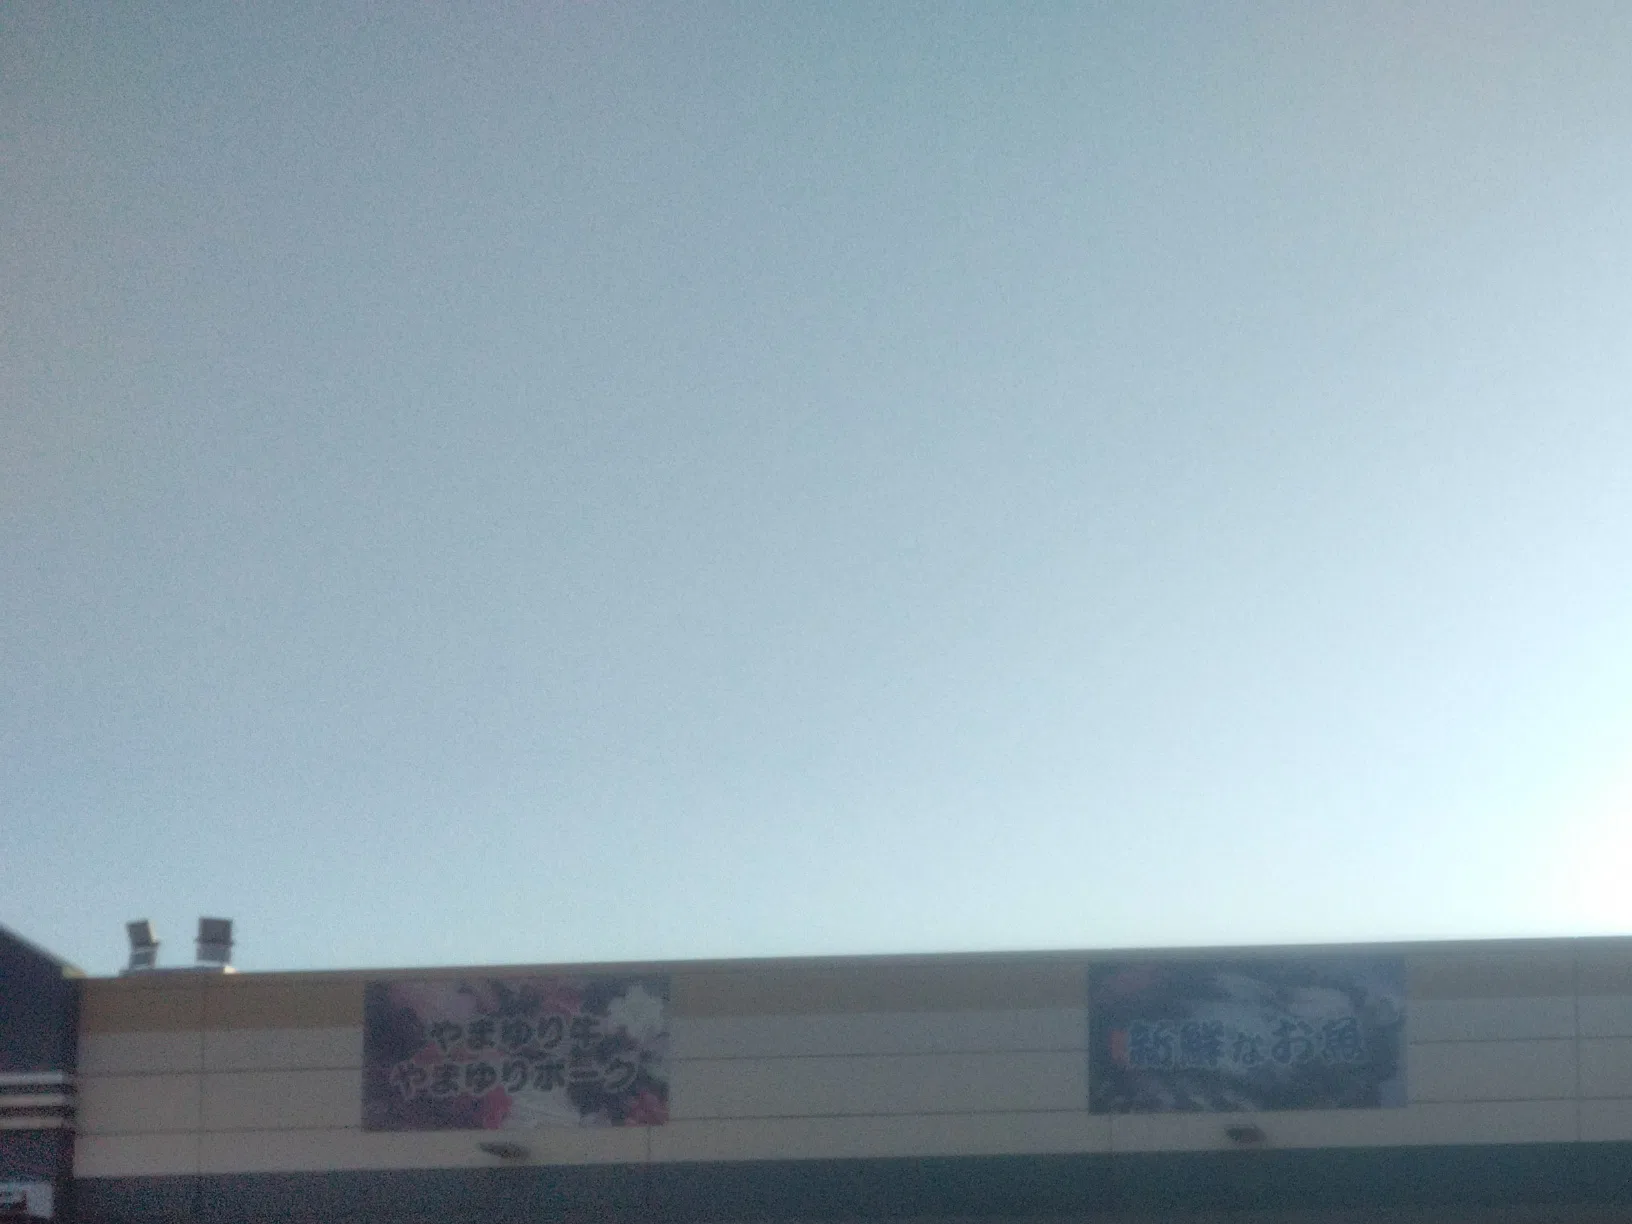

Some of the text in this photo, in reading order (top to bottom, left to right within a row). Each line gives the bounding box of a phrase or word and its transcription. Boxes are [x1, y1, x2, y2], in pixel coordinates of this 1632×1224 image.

[1127, 1017, 1363, 1068] 新鮮なお魚
